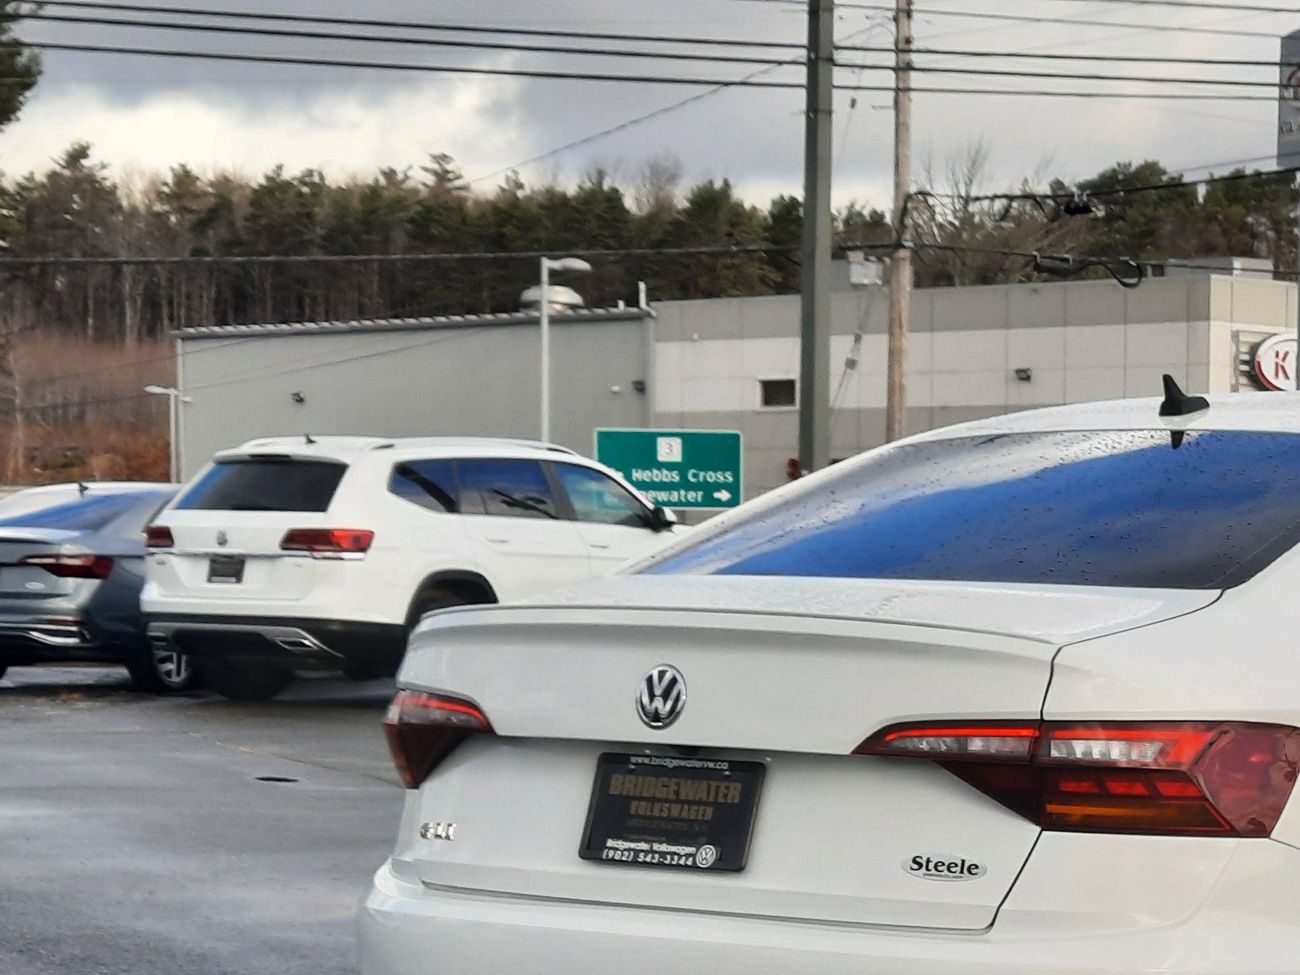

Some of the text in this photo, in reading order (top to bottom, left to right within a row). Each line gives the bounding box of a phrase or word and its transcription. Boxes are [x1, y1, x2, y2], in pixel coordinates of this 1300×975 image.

[631, 468, 734, 483] Hebbs Cross
[640, 489, 704, 502] ewater
[609, 774, 742, 803] BRIDGEWATER
[629, 801, 714, 821] VOLKSWAGEN
[602, 849, 693, 866] (902) 543-3344
[910, 855, 979, 876] Steele
